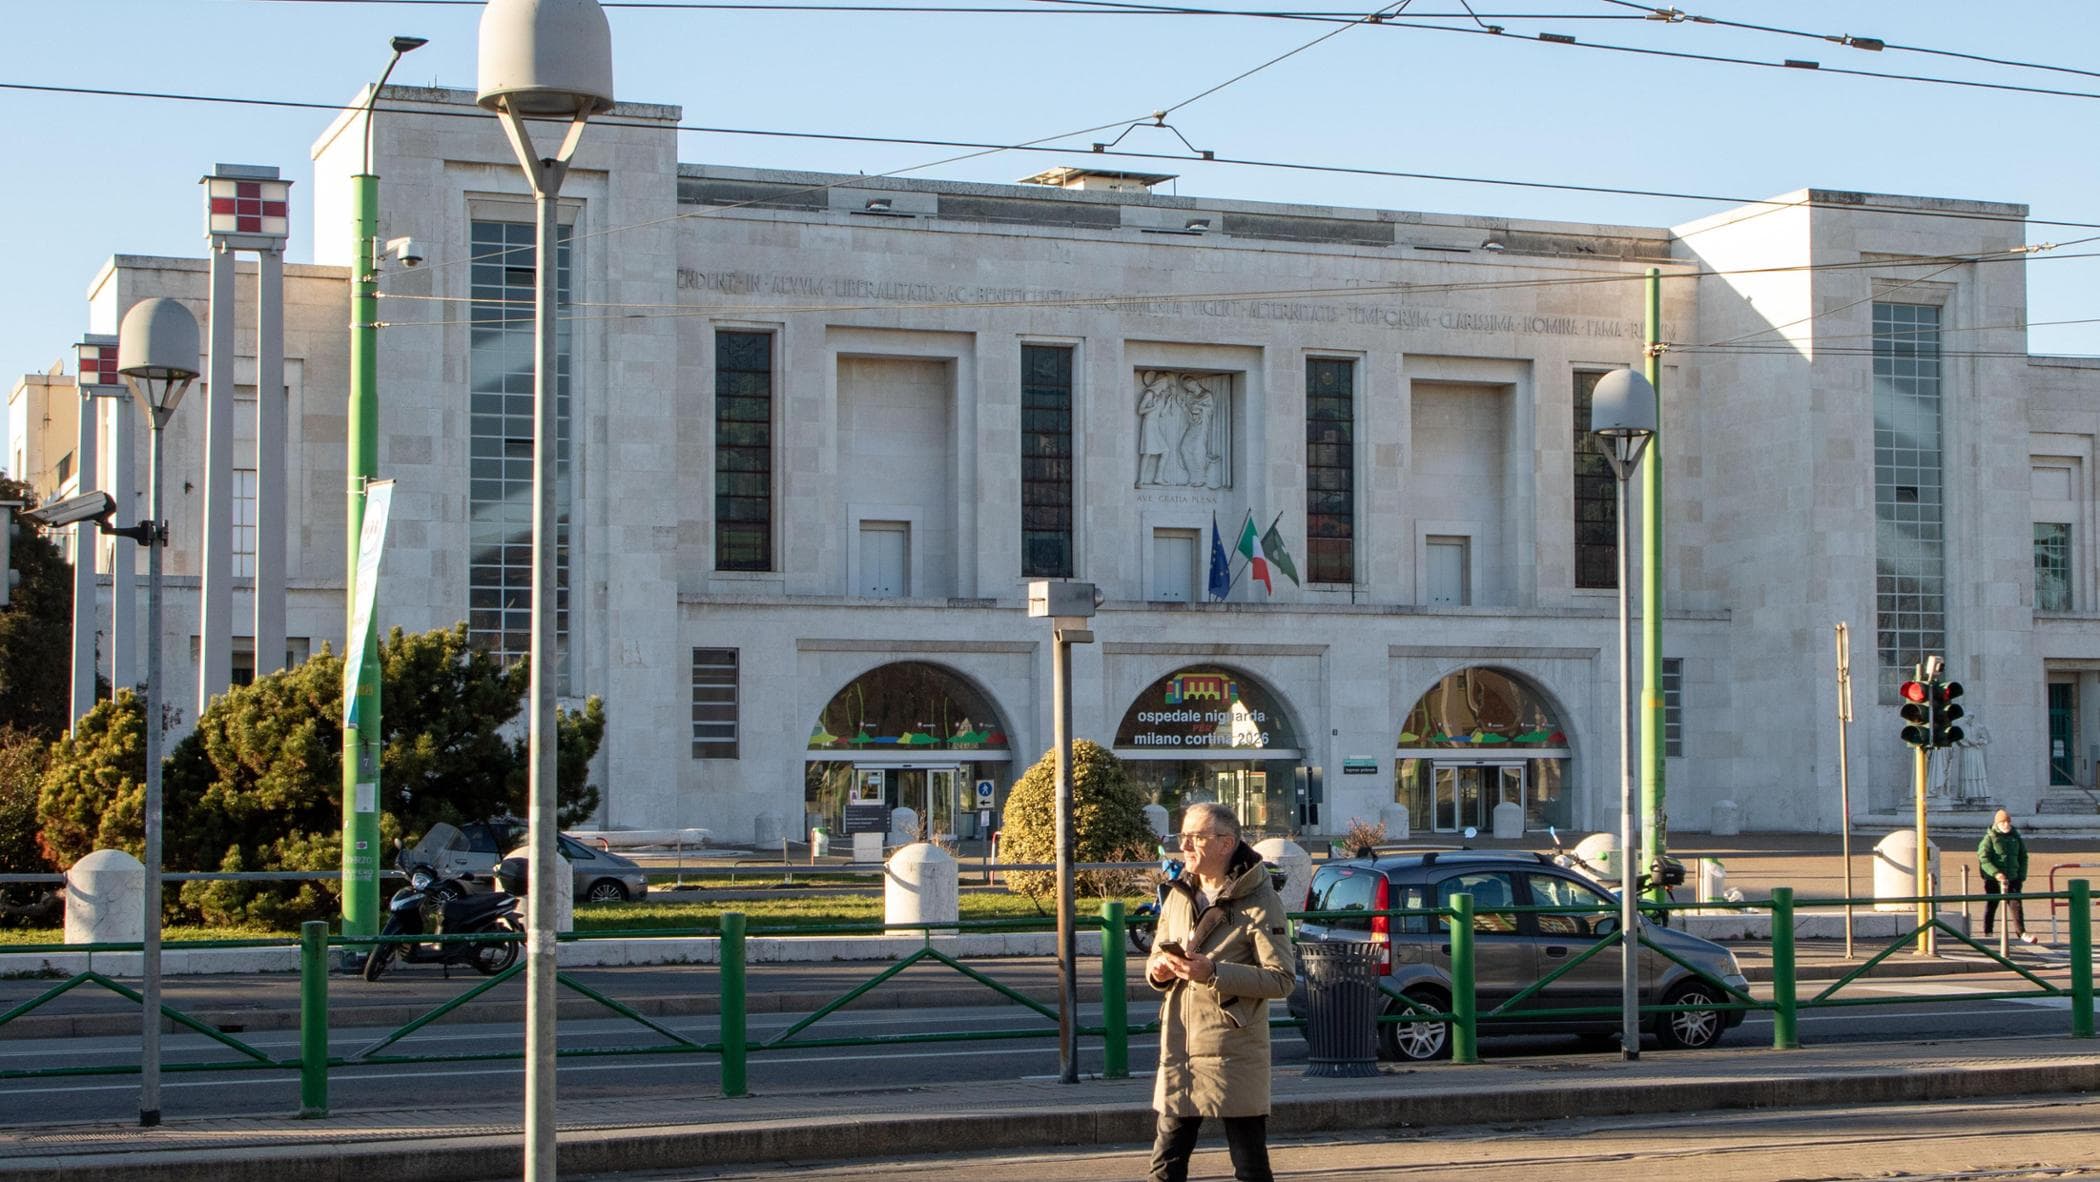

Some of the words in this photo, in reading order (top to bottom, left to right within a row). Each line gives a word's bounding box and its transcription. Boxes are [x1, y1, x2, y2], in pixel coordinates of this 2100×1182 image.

[677, 268, 736, 293] ENDENT
[745, 273, 761, 292] IN
[945, 284, 967, 303] AC
[1138, 709, 1200, 725] ospedale
[1135, 732, 1181, 745] milano
[1185, 732, 1232, 745] cortina
[1238, 732, 1270, 745] 2026
[363, 758, 369, 767] 7
